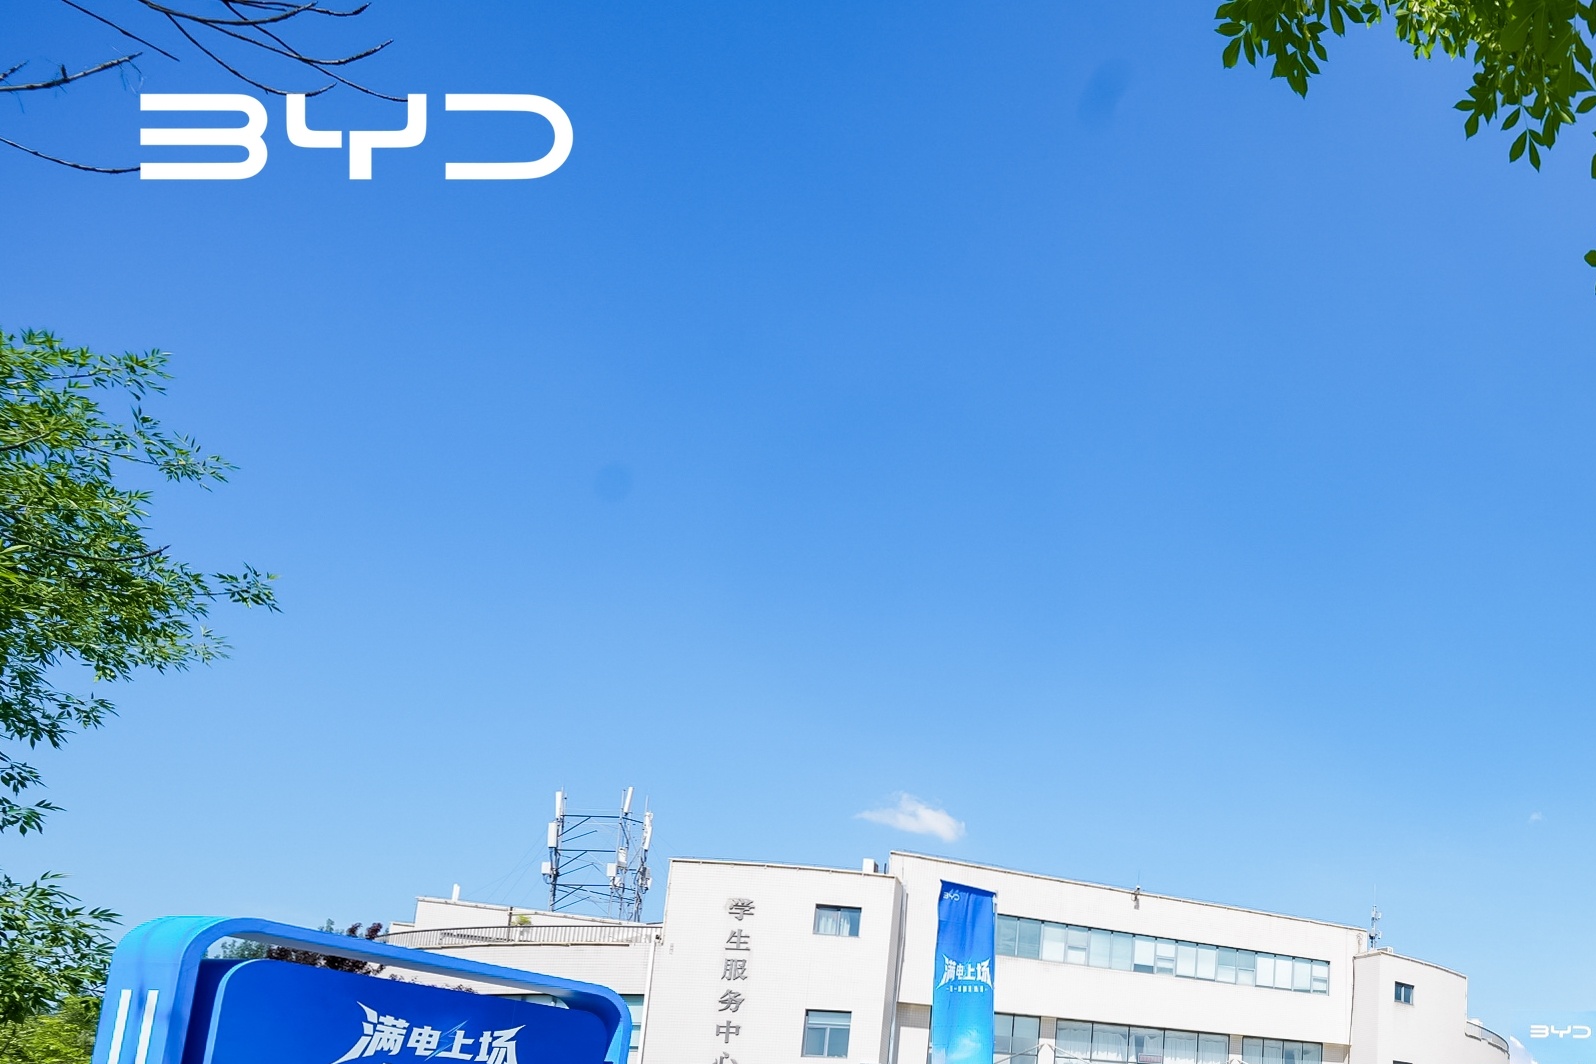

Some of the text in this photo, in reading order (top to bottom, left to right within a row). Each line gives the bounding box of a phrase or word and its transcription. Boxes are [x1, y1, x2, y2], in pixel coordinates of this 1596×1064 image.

[943, 891, 960, 901] BYD
[936, 954, 993, 989] 满电上场
[1530, 1024, 1592, 1039] BYD
